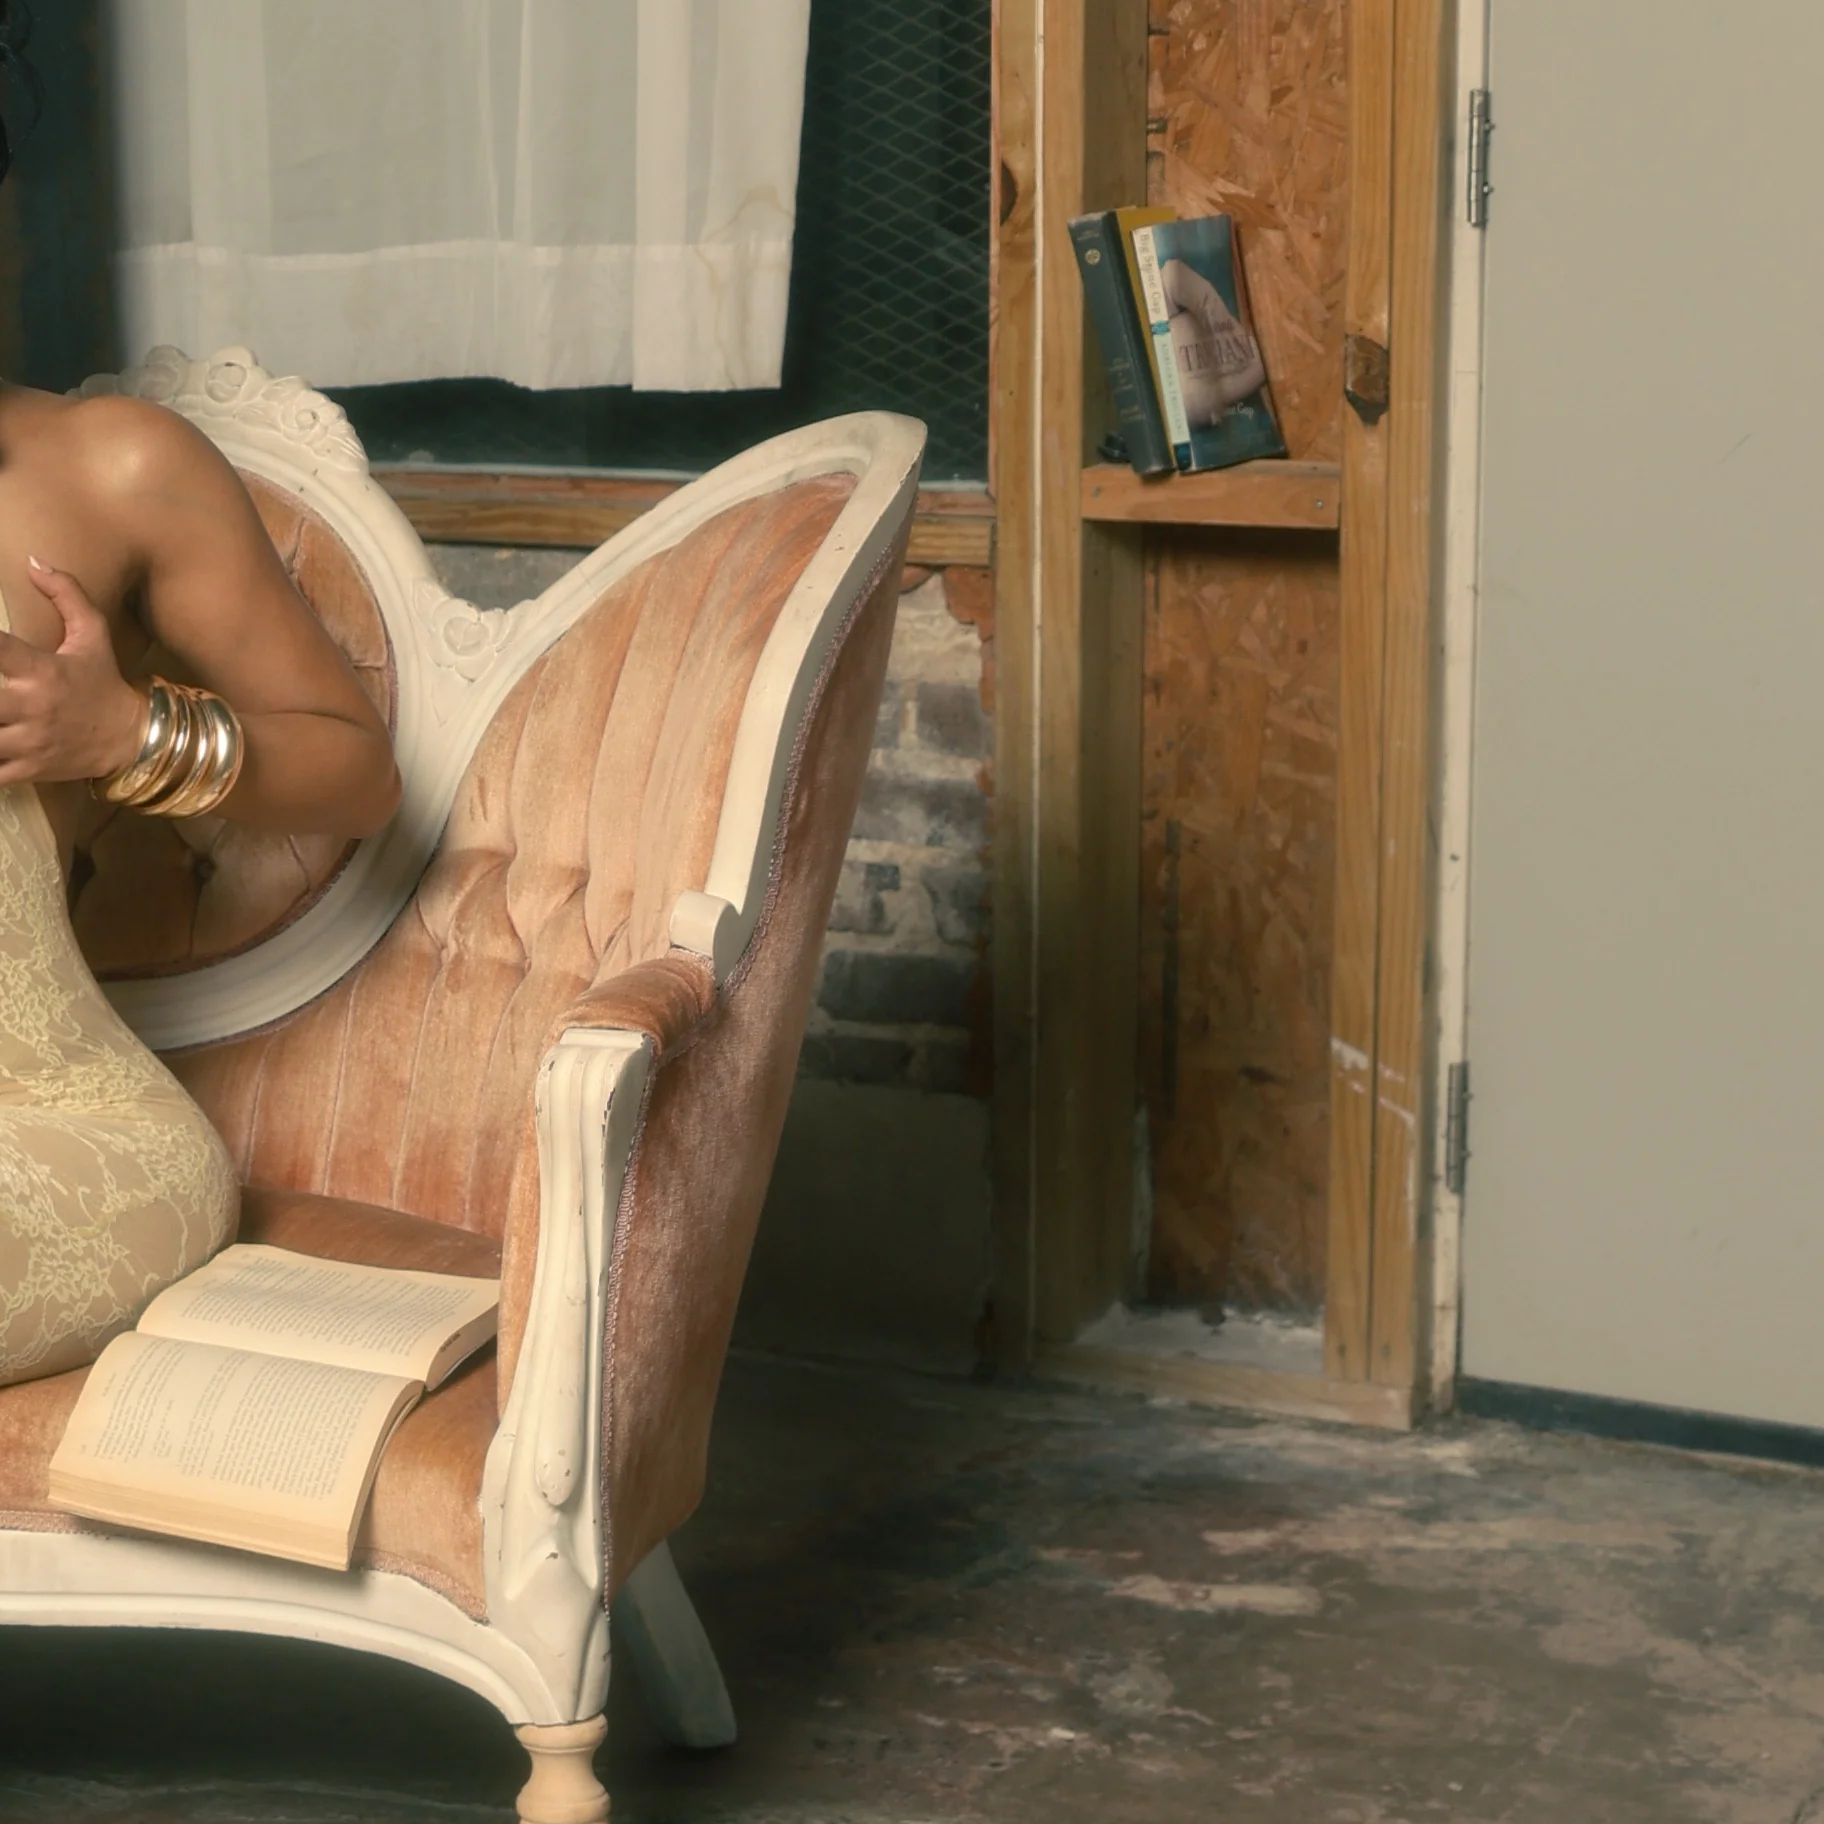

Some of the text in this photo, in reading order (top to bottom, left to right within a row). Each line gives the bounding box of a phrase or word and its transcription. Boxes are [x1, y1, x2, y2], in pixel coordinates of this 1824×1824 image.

[1139, 234, 1151, 254] Big
[1141, 256, 1157, 287] Stone
[1151, 291, 1163, 314] Gap
